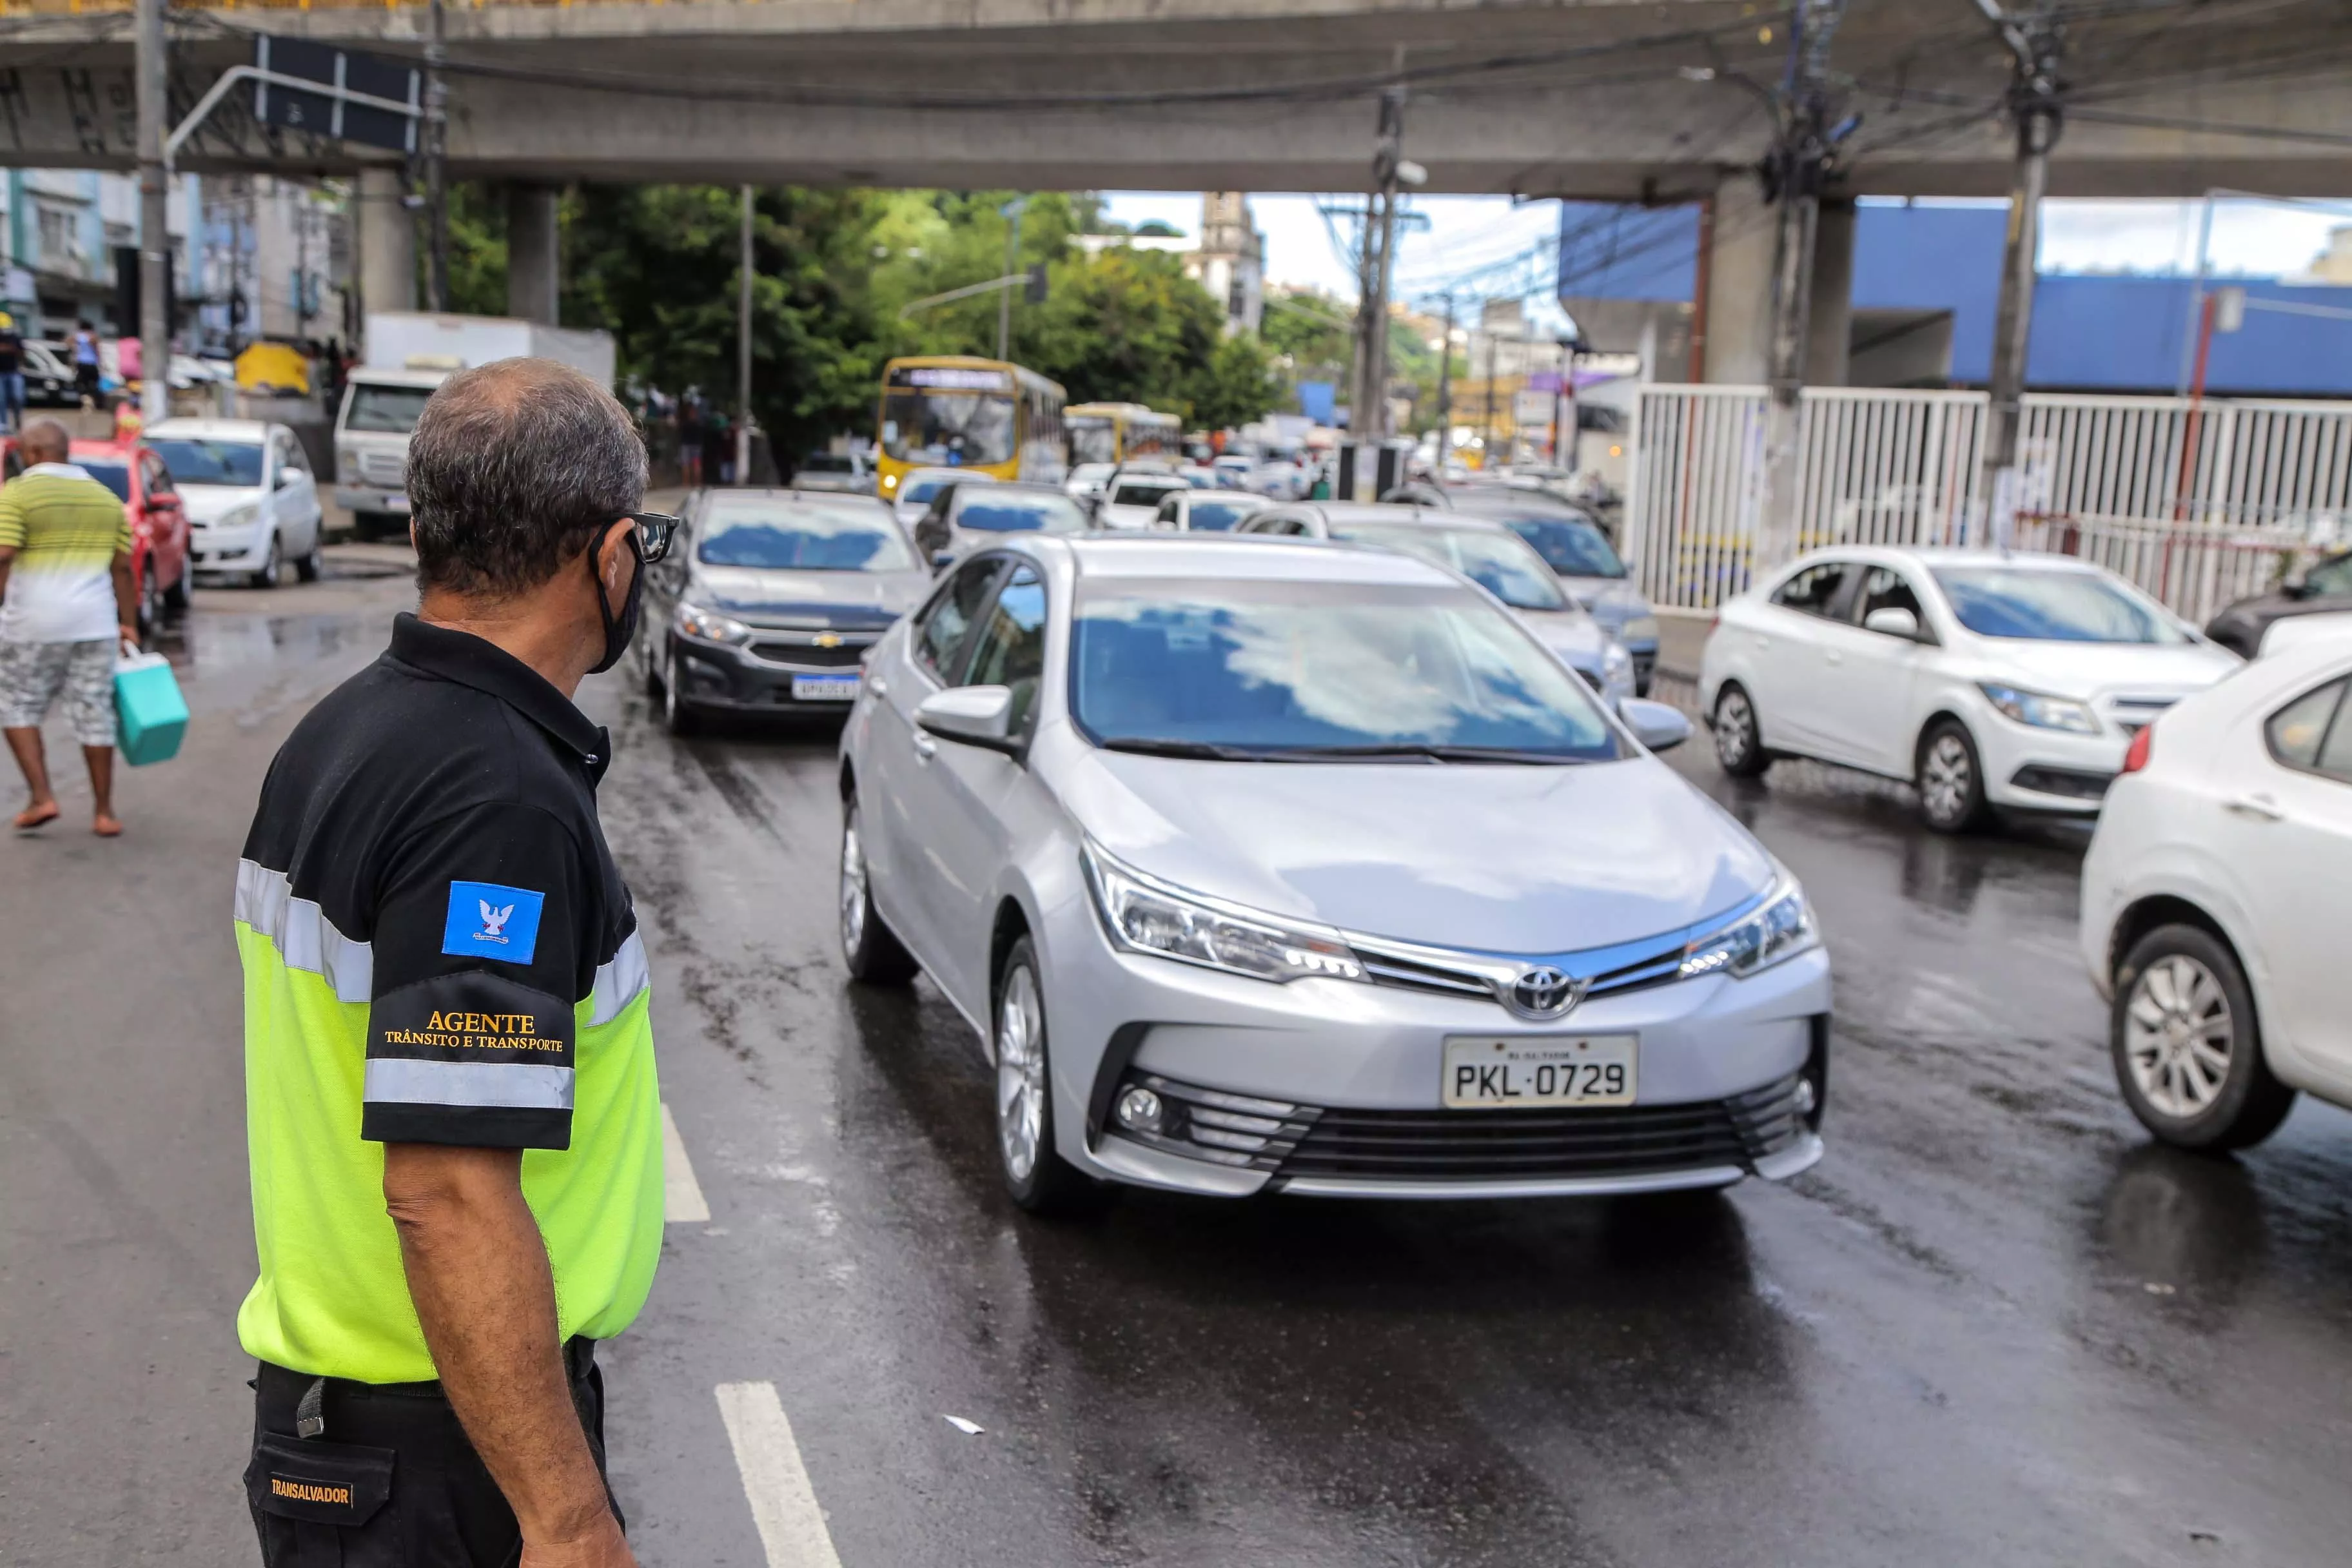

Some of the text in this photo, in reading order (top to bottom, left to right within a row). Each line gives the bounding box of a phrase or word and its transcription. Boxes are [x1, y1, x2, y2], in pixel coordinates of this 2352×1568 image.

[427, 1011, 535, 1034] AGENTE
[386, 1030, 563, 1052] TRÂNSITO E TRANSPORTE
[272, 1479, 349, 1504] TRANSALVADOR
